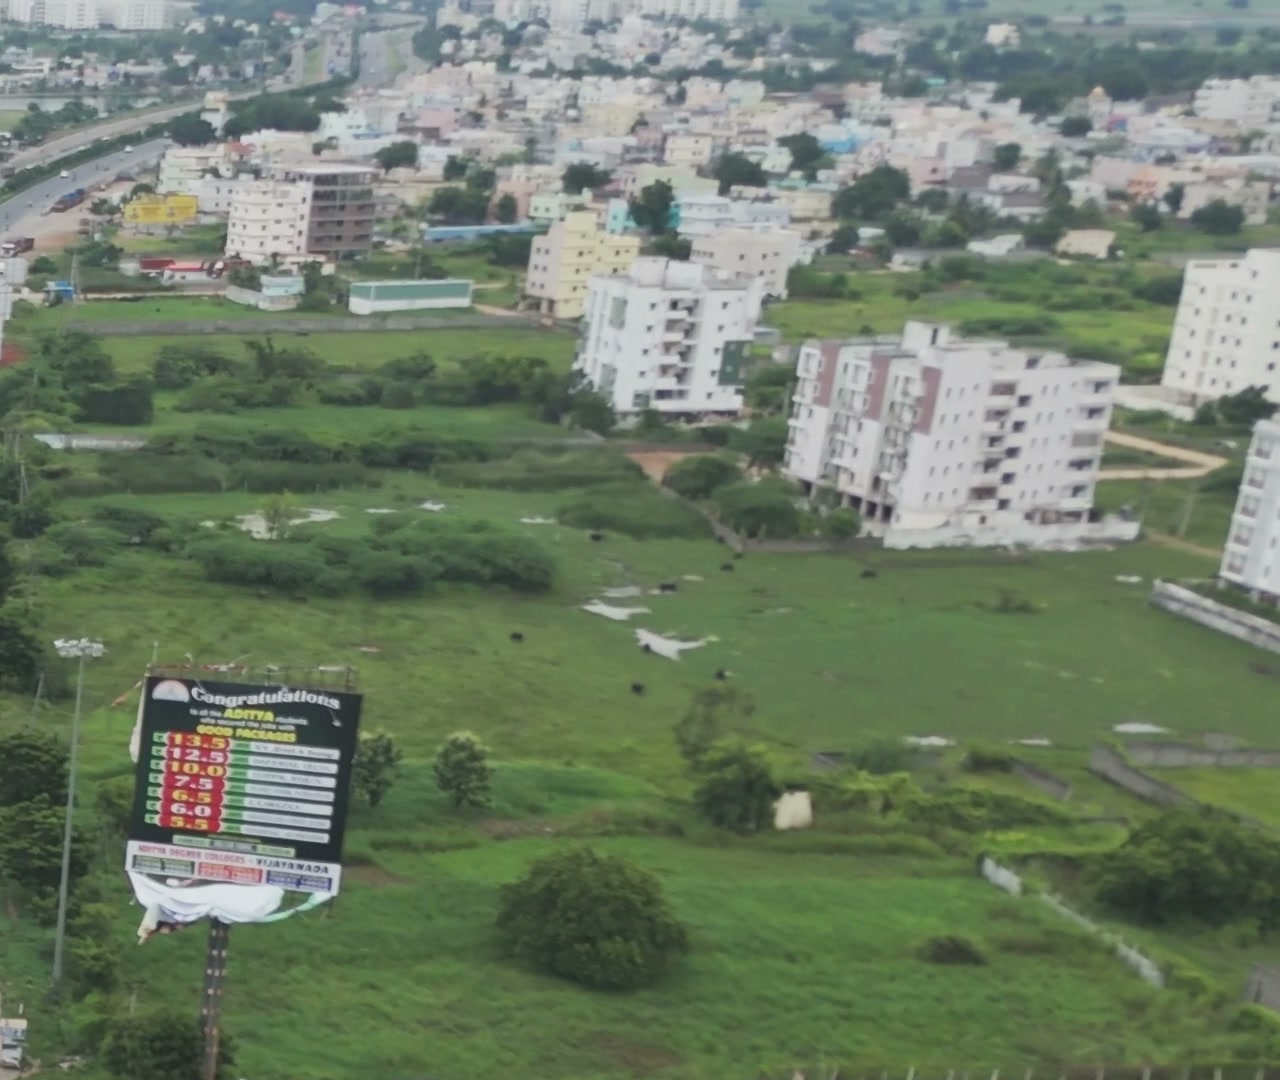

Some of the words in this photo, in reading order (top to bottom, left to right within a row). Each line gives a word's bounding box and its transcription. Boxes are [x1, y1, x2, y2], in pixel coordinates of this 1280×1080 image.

[191, 687, 340, 709] Congratulations
[223, 708, 275, 722] ADITYA
[171, 733, 226, 749] 13.5
[235, 728, 297, 743] PACKAGES
[169, 747, 225, 763] 12.5
[168, 761, 224, 777] 10.0
[174, 775, 213, 790] 7.5
[172, 789, 211, 804] 6.5
[170, 803, 211, 817] 6.0
[170, 816, 208, 830] 5.5
[256, 858, 329, 874] VIJAYAWADA
